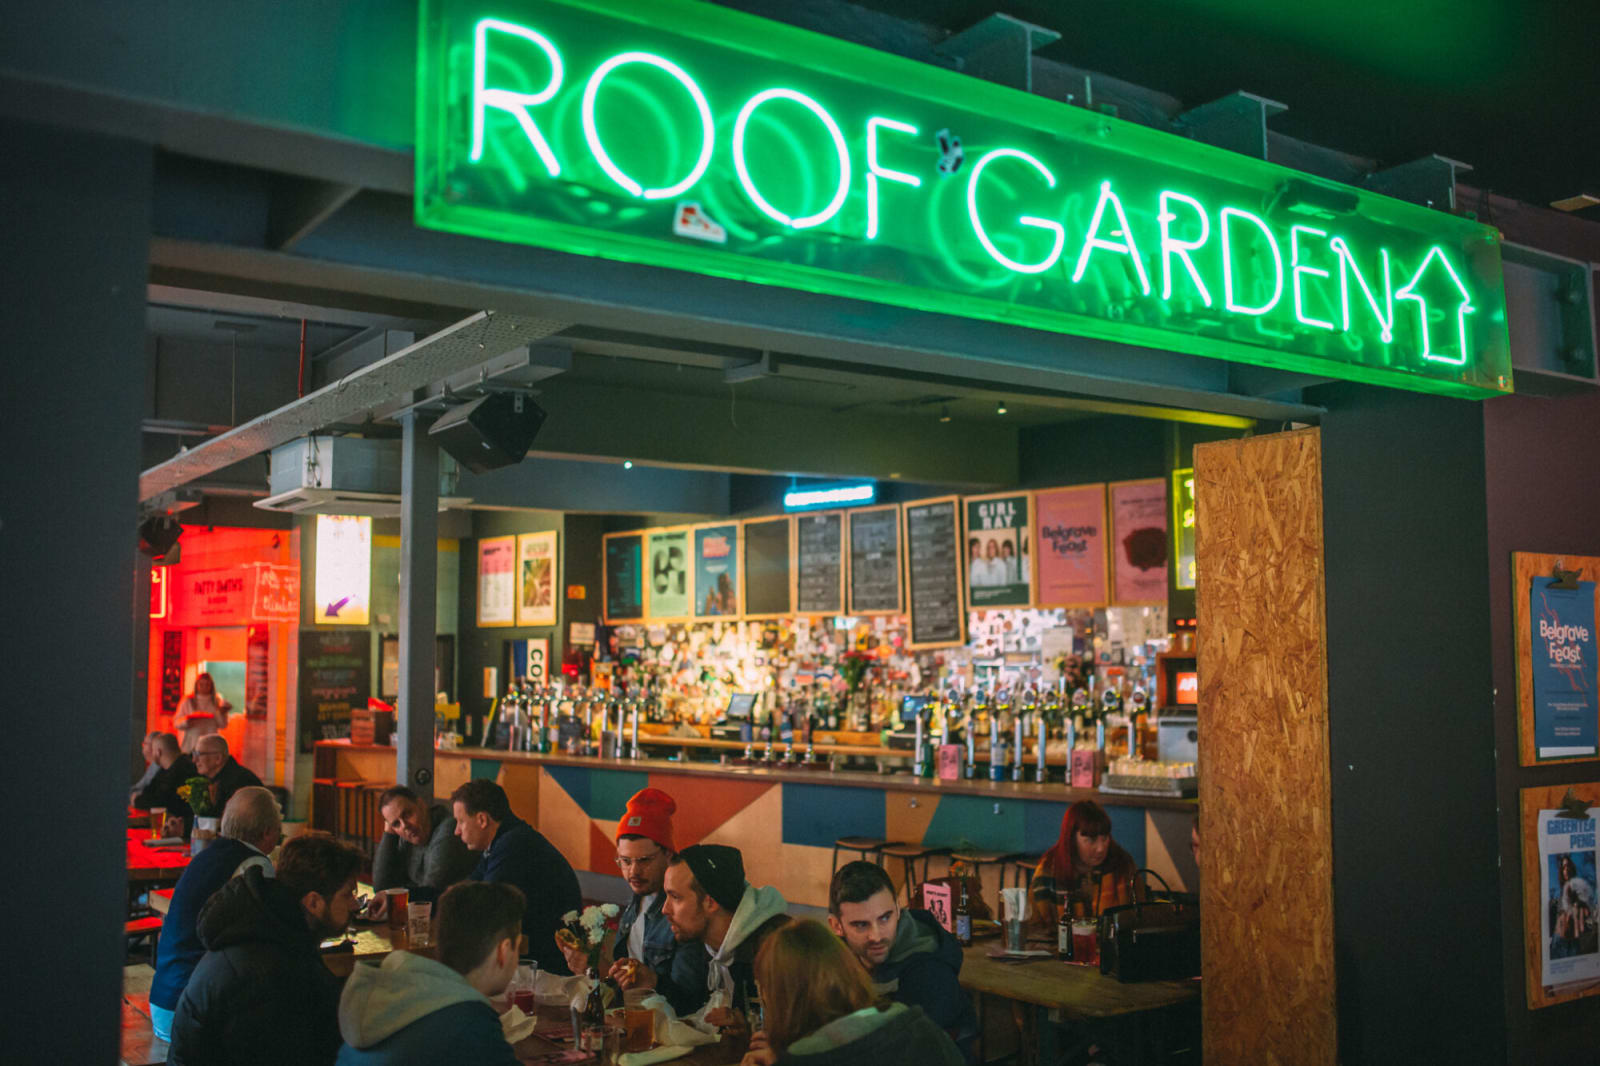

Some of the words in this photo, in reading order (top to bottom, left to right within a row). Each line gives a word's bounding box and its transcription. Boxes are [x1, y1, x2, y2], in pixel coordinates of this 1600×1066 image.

[468, 17, 922, 241] ROOF
[966, 147, 1394, 343] GARDEN
[978, 502, 1017, 518] GIRL
[982, 515, 1013, 530] RAY
[1041, 525, 1097, 542] Belgrave
[1052, 540, 1088, 554] Feast
[1539, 619, 1589, 645] Belgrave
[1549, 642, 1581, 664] Feast
